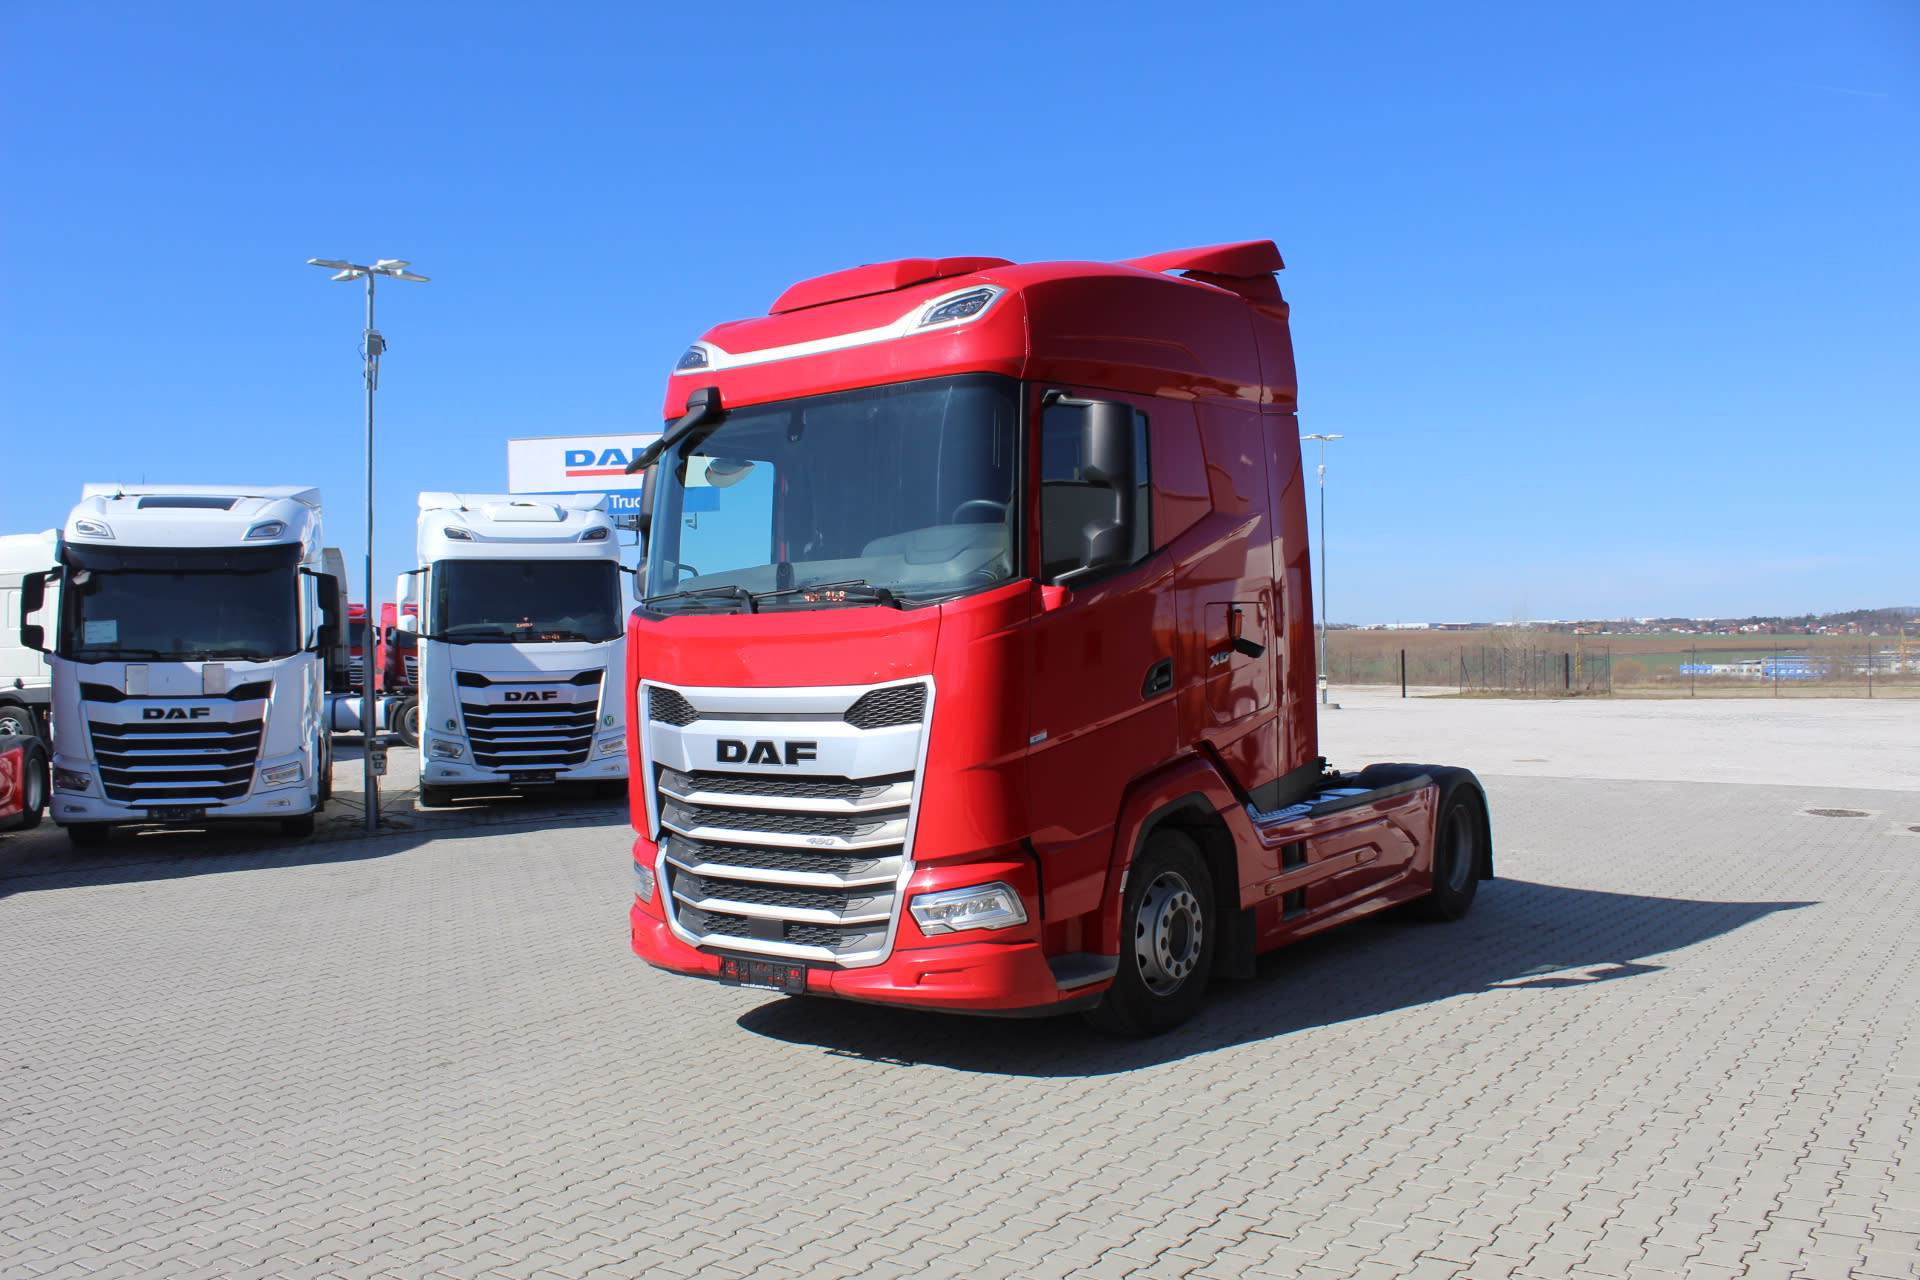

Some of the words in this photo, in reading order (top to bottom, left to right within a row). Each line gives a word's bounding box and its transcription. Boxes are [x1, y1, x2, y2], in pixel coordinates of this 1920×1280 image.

[504, 691, 558, 701] DAF
[142, 707, 211, 720] DAF
[716, 739, 818, 766] DAF
